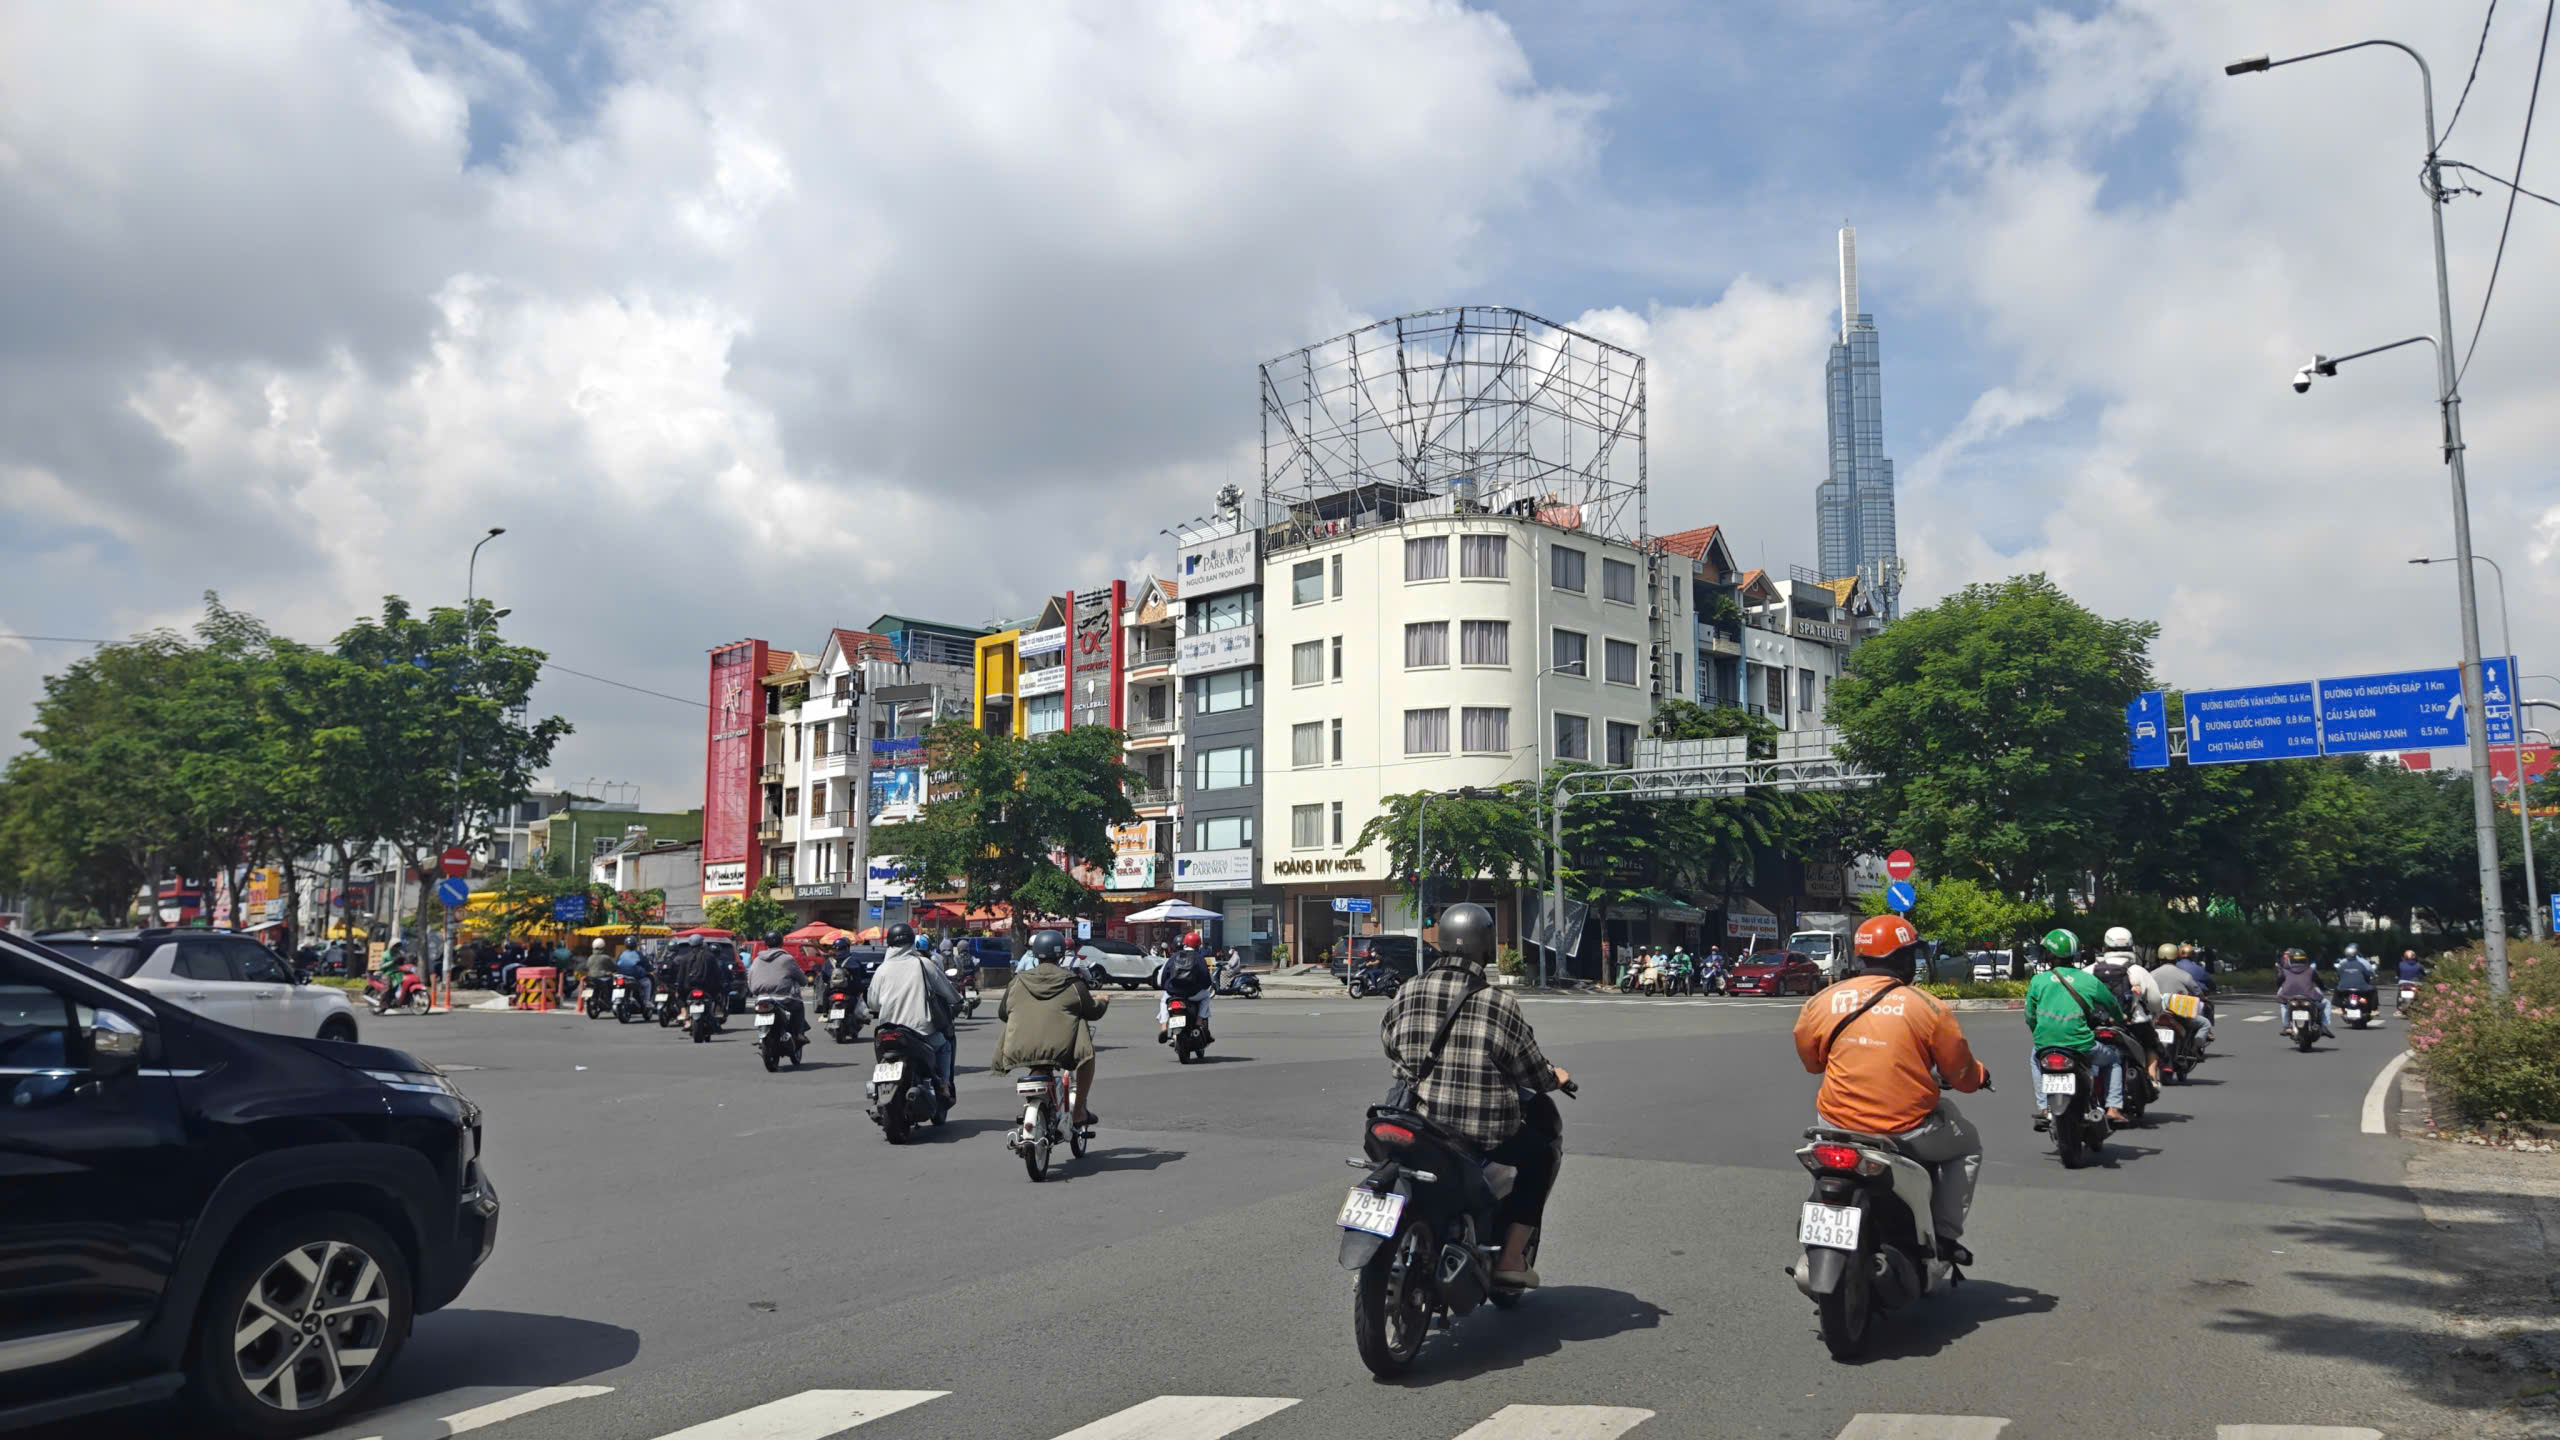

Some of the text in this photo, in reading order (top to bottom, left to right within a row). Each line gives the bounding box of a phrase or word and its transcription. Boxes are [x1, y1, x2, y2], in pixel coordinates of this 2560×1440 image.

[1203, 553, 1246, 572] PARKWAY
[1799, 622, 1815, 635] SPA
[2324, 679, 2445, 699] ĐƯỜNG VÕ NGUYÊN GIÁP 1 Km
[2201, 698, 2223, 711] ĐƯỜNG
[2300, 693, 2312, 702] Km
[847, 671, 859, 755] HOTEL
[2326, 703, 2446, 720] CẦU SÀI GÒN 1.2 Km
[2205, 719, 2231, 731] ĐƯỜNG
[2233, 715, 2254, 728] QUỐC
[2286, 715, 2297, 725] 0.8
[2298, 714, 2311, 723] Km
[2346, 730, 2358, 741] TƯ
[2358, 729, 2382, 740] HÀNG
[2383, 728, 2407, 739] XANH
[2421, 727, 2432, 736] 6.5
[2434, 726, 2448, 735] Km
[2208, 735, 2314, 752] CHỢ THẢO ĐIỀN 0.9 Km
[1192, 863, 1229, 876] PARKWAY
[1274, 857, 1313, 875] HOÀNG
[1335, 858, 1366, 872] HOTEL
[798, 886, 833, 897] SALA HOTEL
[1863, 1002, 1905, 1016] ood
[1345, 1208, 1395, 1234] 327.76
[1804, 1224, 1854, 1246] 343.62
